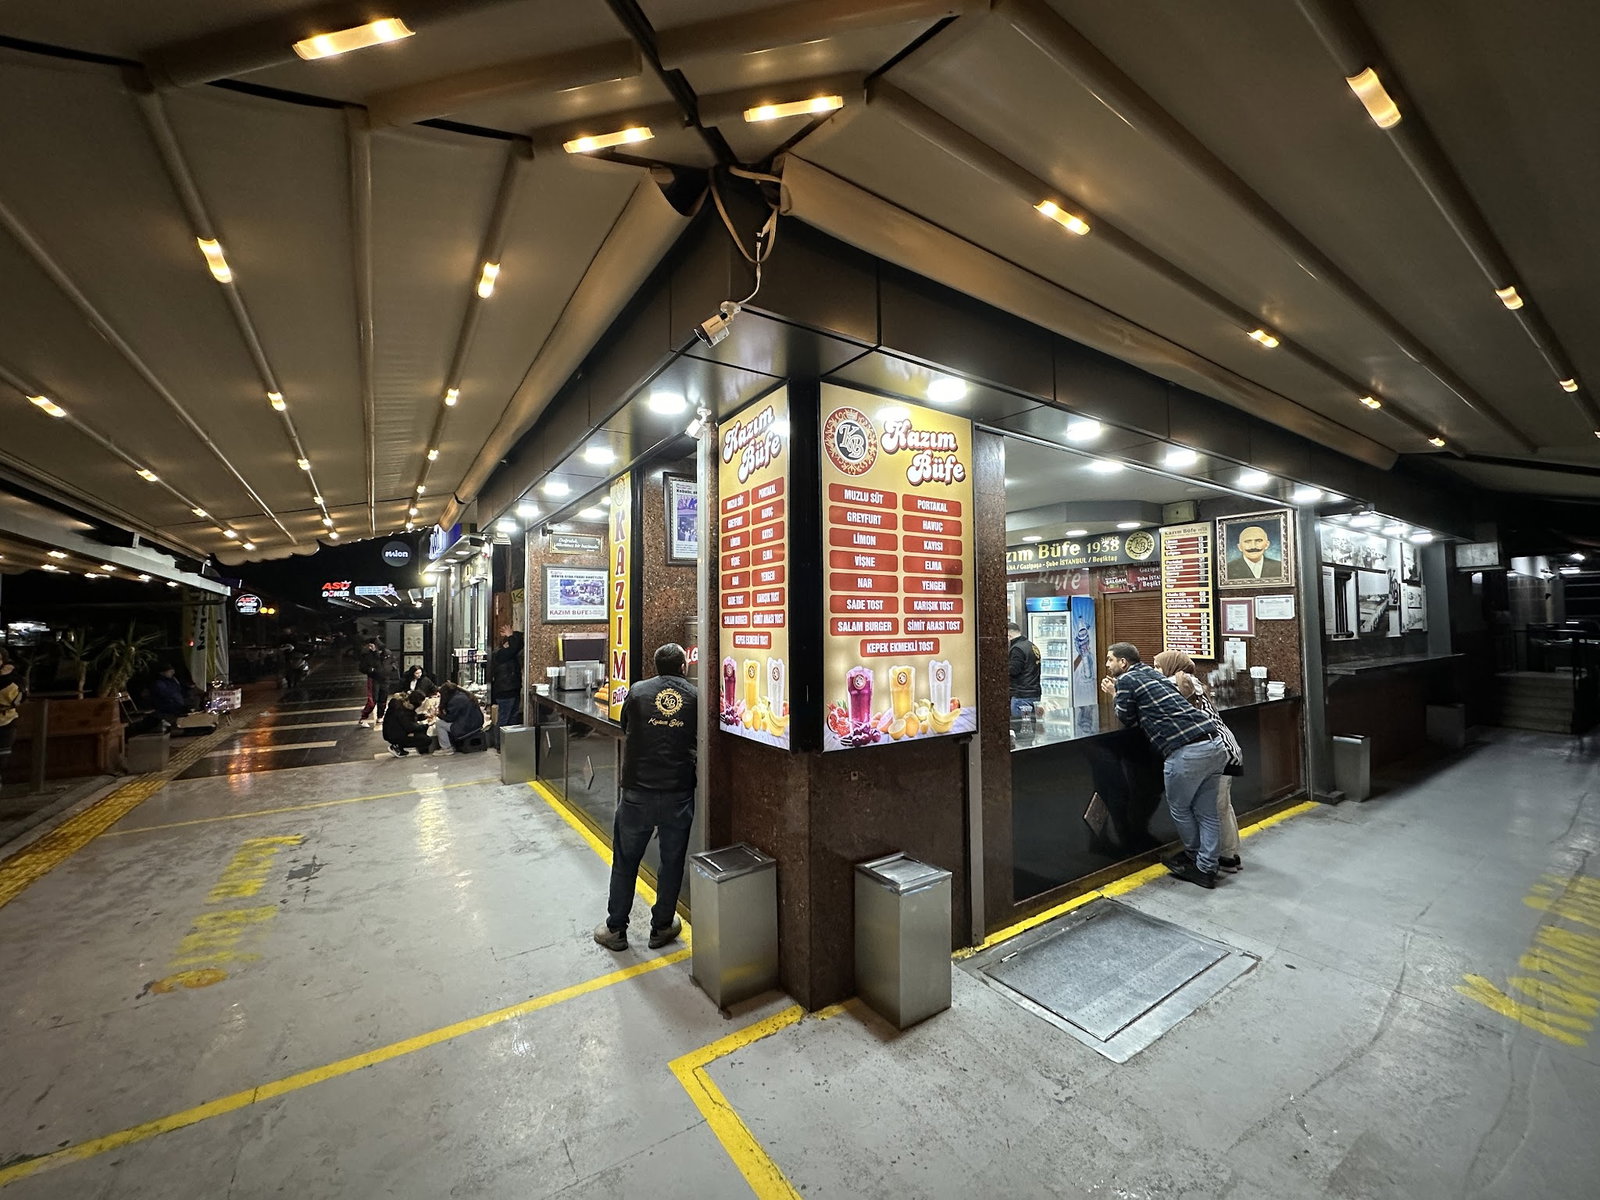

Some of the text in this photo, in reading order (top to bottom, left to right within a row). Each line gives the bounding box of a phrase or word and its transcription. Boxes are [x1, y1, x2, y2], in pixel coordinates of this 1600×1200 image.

[722, 404, 775, 464] Kazım
[880, 418, 958, 454] Kazım
[738, 430, 782, 484] Büfe
[906, 451, 966, 486] Büfe
[844, 489, 884, 504] MUZLU SÜT
[917, 500, 948, 512] PORTAKAL
[846, 512, 882, 525] GREYFURT
[922, 520, 944, 532] HAVUÇ
[853, 532, 876, 546] LİMON
[924, 540, 944, 552] KAYISI
[1006, 540, 1120, 562] zım Büfe 1938
[854, 554, 876, 567] VİŞNE
[924, 560, 942, 571] ELMA
[858, 578, 872, 588] NAR
[922, 581, 946, 590] YENGEN
[1142, 580, 1161, 588] Beşikt
[612, 510, 627, 681] KAZIM
[846, 600, 883, 610] SADE TOST
[914, 601, 954, 612] KARIŞIK TOST
[838, 622, 892, 632] SALAM BURGER
[908, 620, 960, 631] SİMİT ARASI TOST
[866, 640, 934, 653] KEPEK EKMEKLİ TOST
